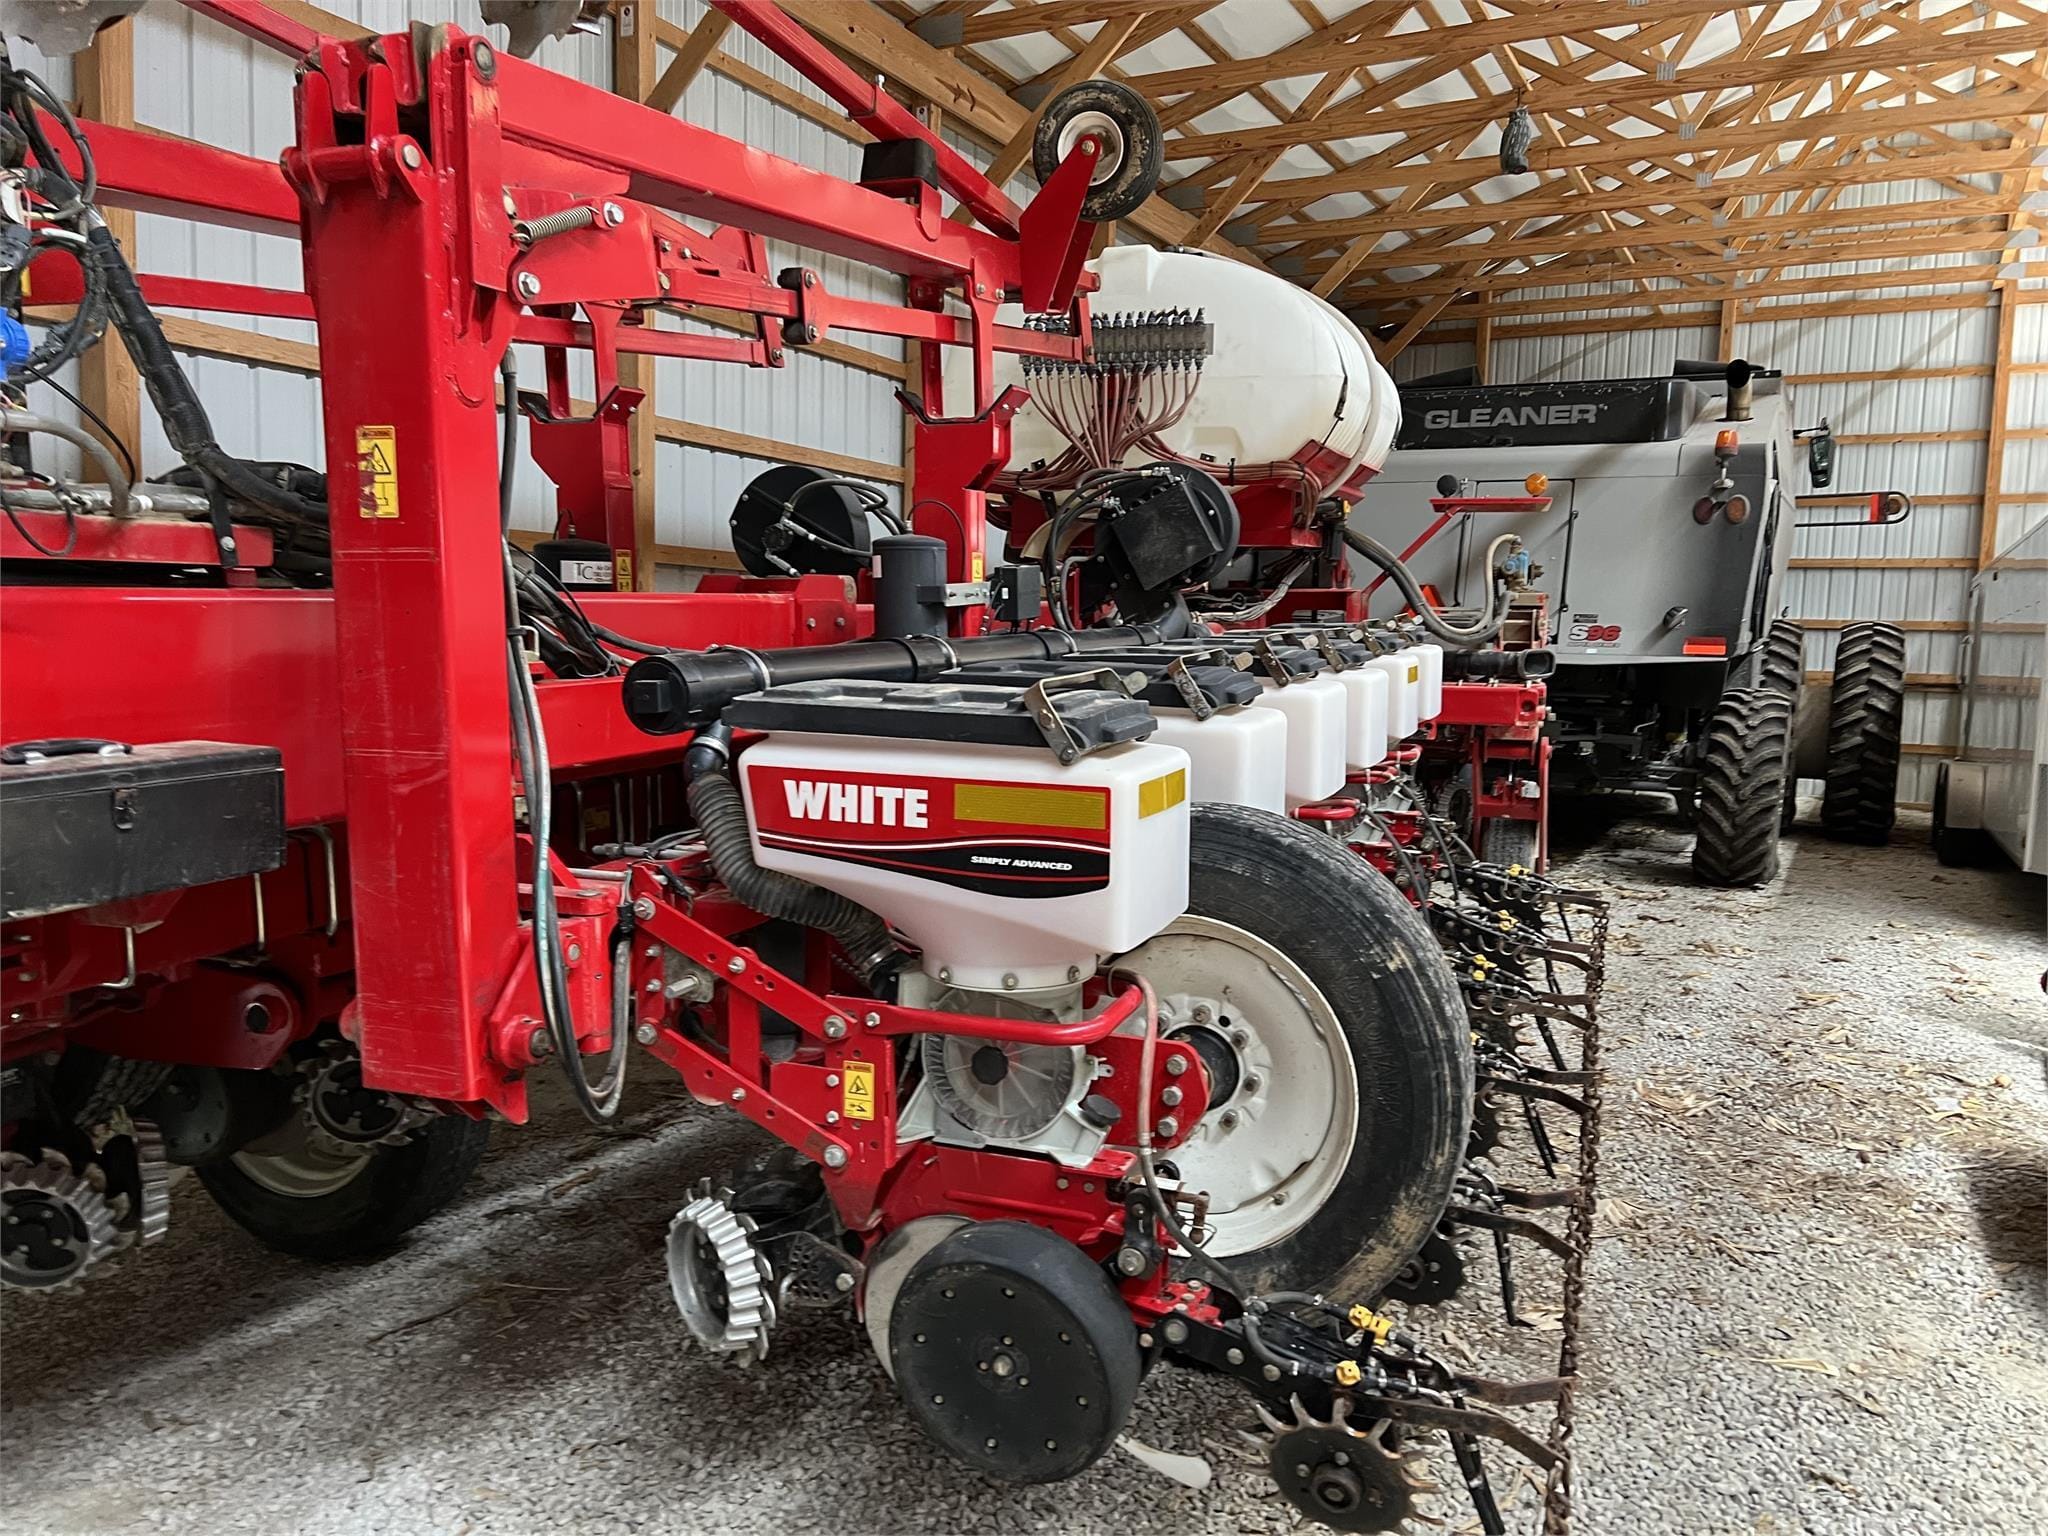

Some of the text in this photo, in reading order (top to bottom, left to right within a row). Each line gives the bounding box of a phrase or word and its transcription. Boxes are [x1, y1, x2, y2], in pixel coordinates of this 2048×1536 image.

[1424, 404, 1598, 430] GLEANER
[1568, 624, 1622, 642] S96
[782, 779, 929, 829] WHITE
[970, 855, 1073, 871] SIMPLY ADVANCED
